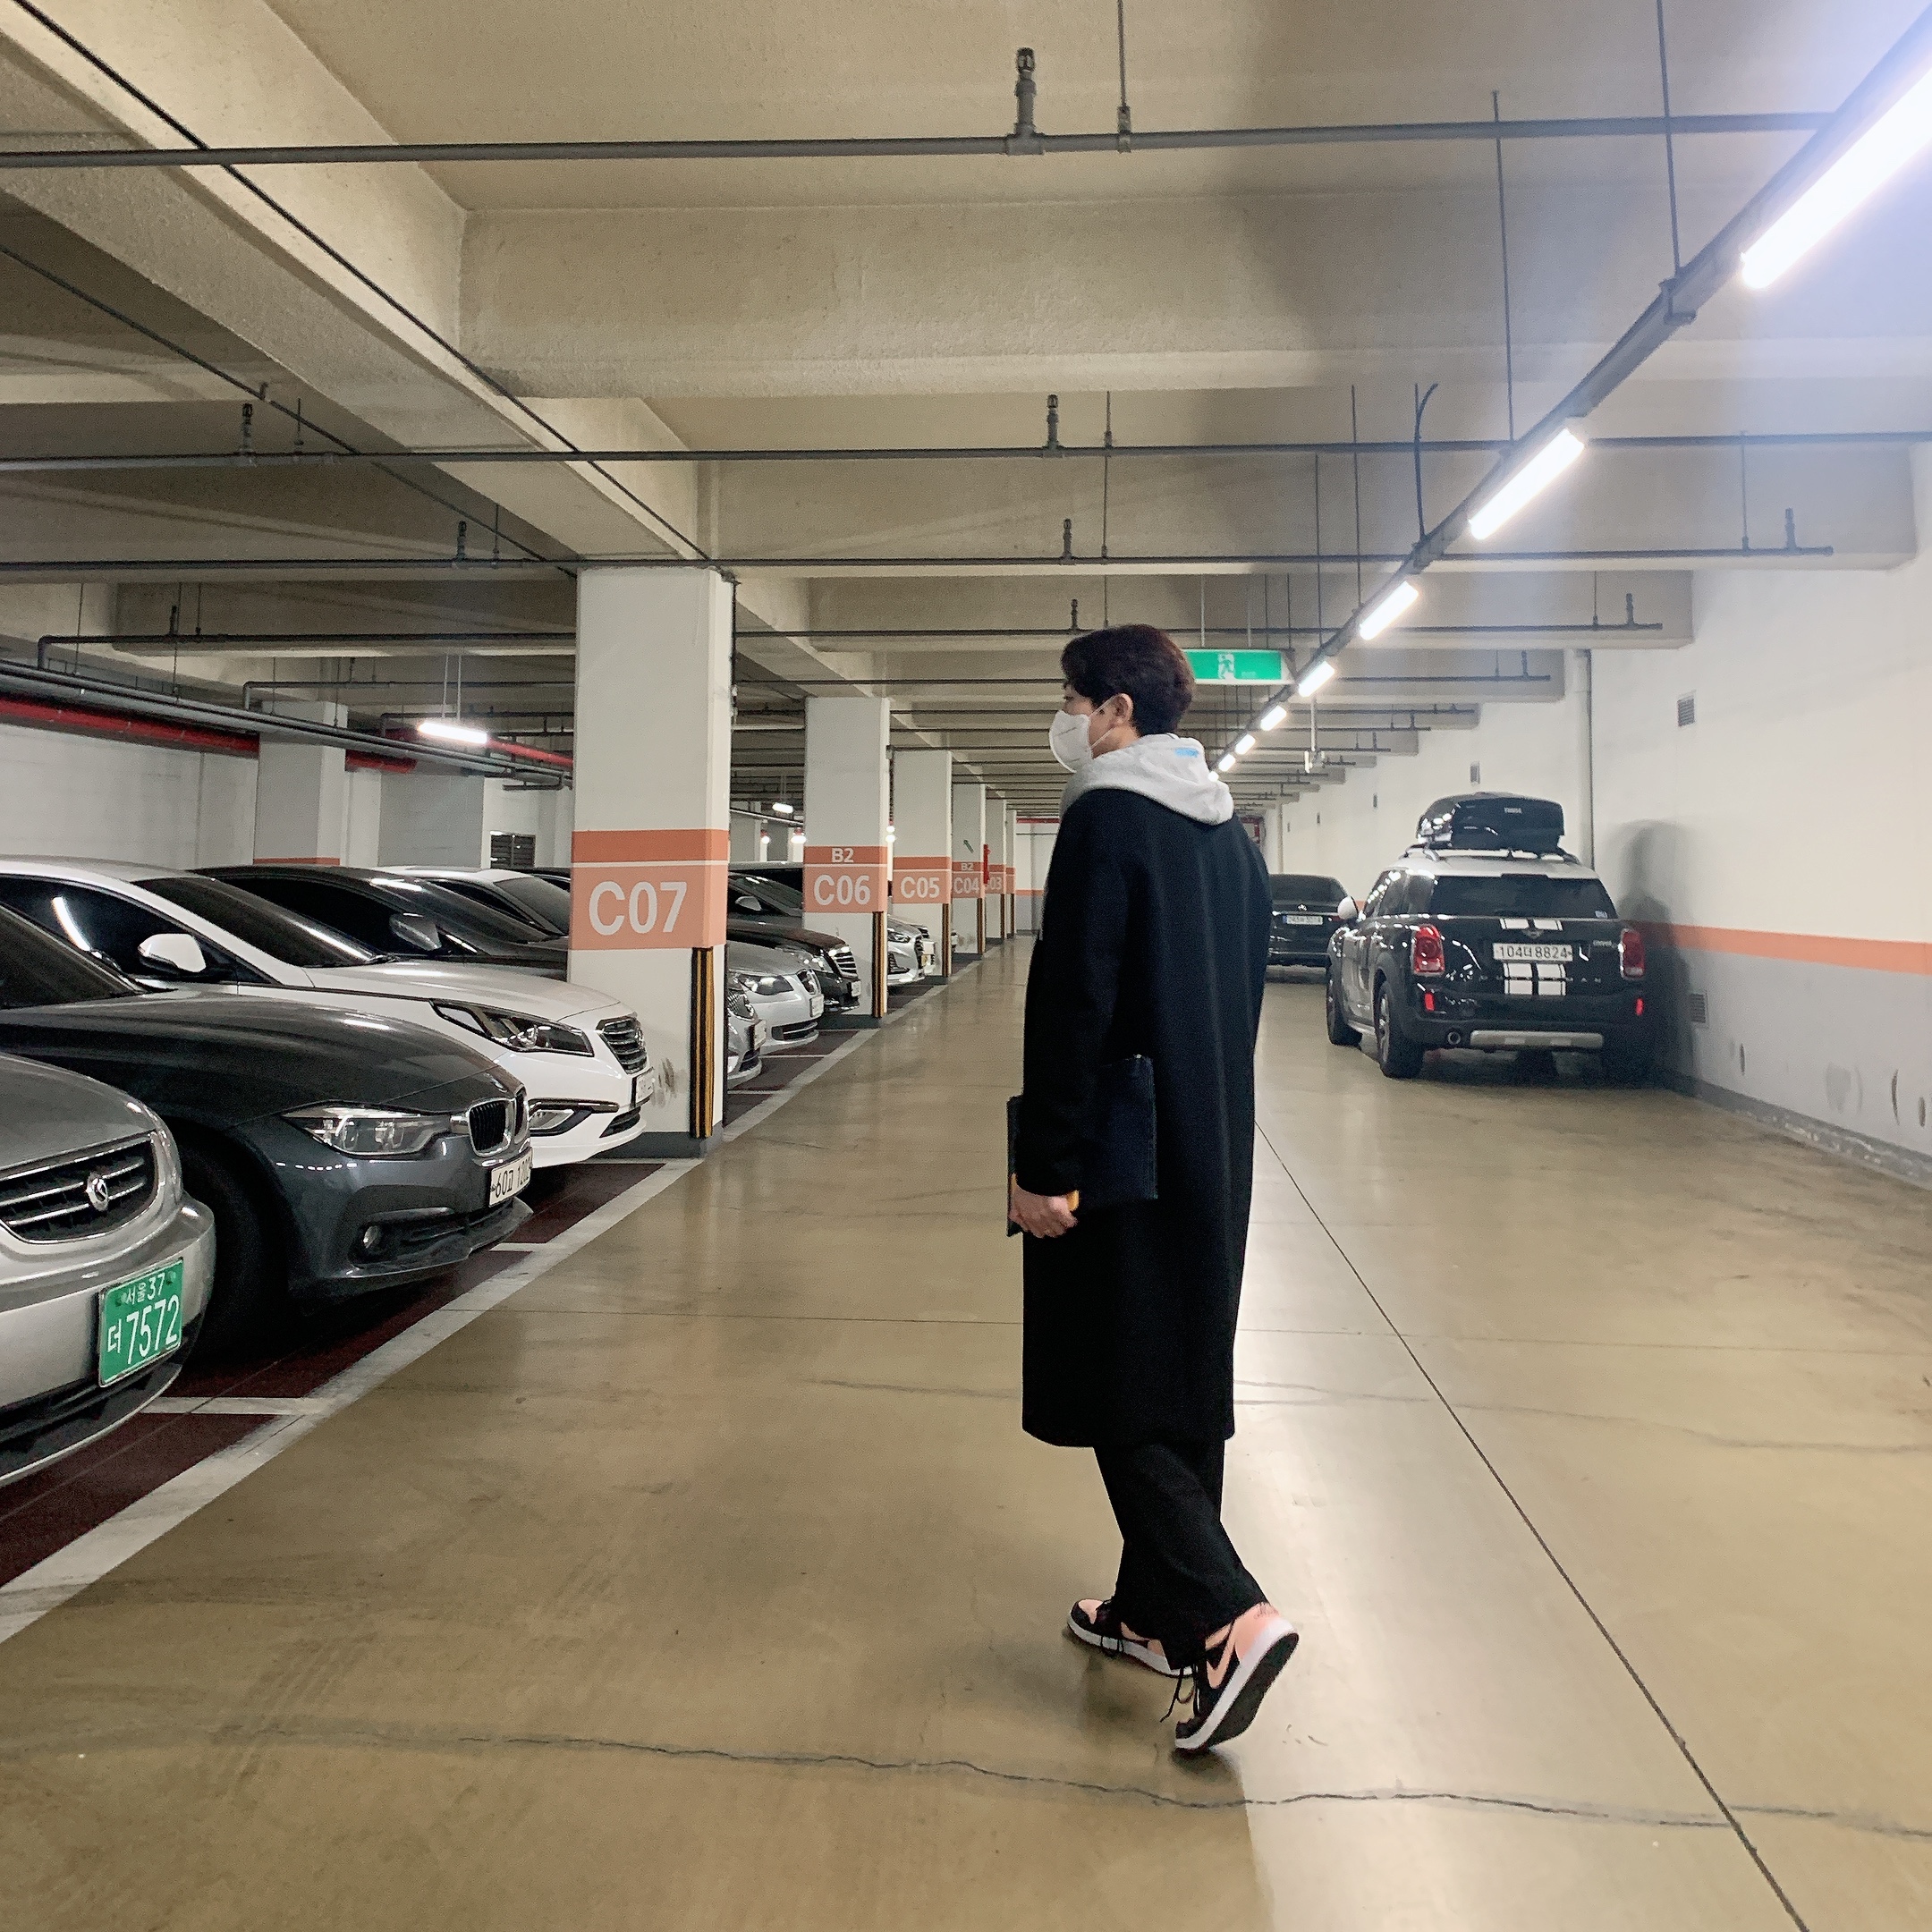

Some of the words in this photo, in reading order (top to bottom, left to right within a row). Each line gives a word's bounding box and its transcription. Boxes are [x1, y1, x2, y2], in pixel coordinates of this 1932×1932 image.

[831, 848, 854, 863] B2
[961, 862, 974, 871] B2
[814, 874, 871, 905] C06
[900, 877, 939, 898] C05
[953, 877, 979, 894] C04
[985, 877, 1002, 891] 03
[589, 881, 687, 936] C07
